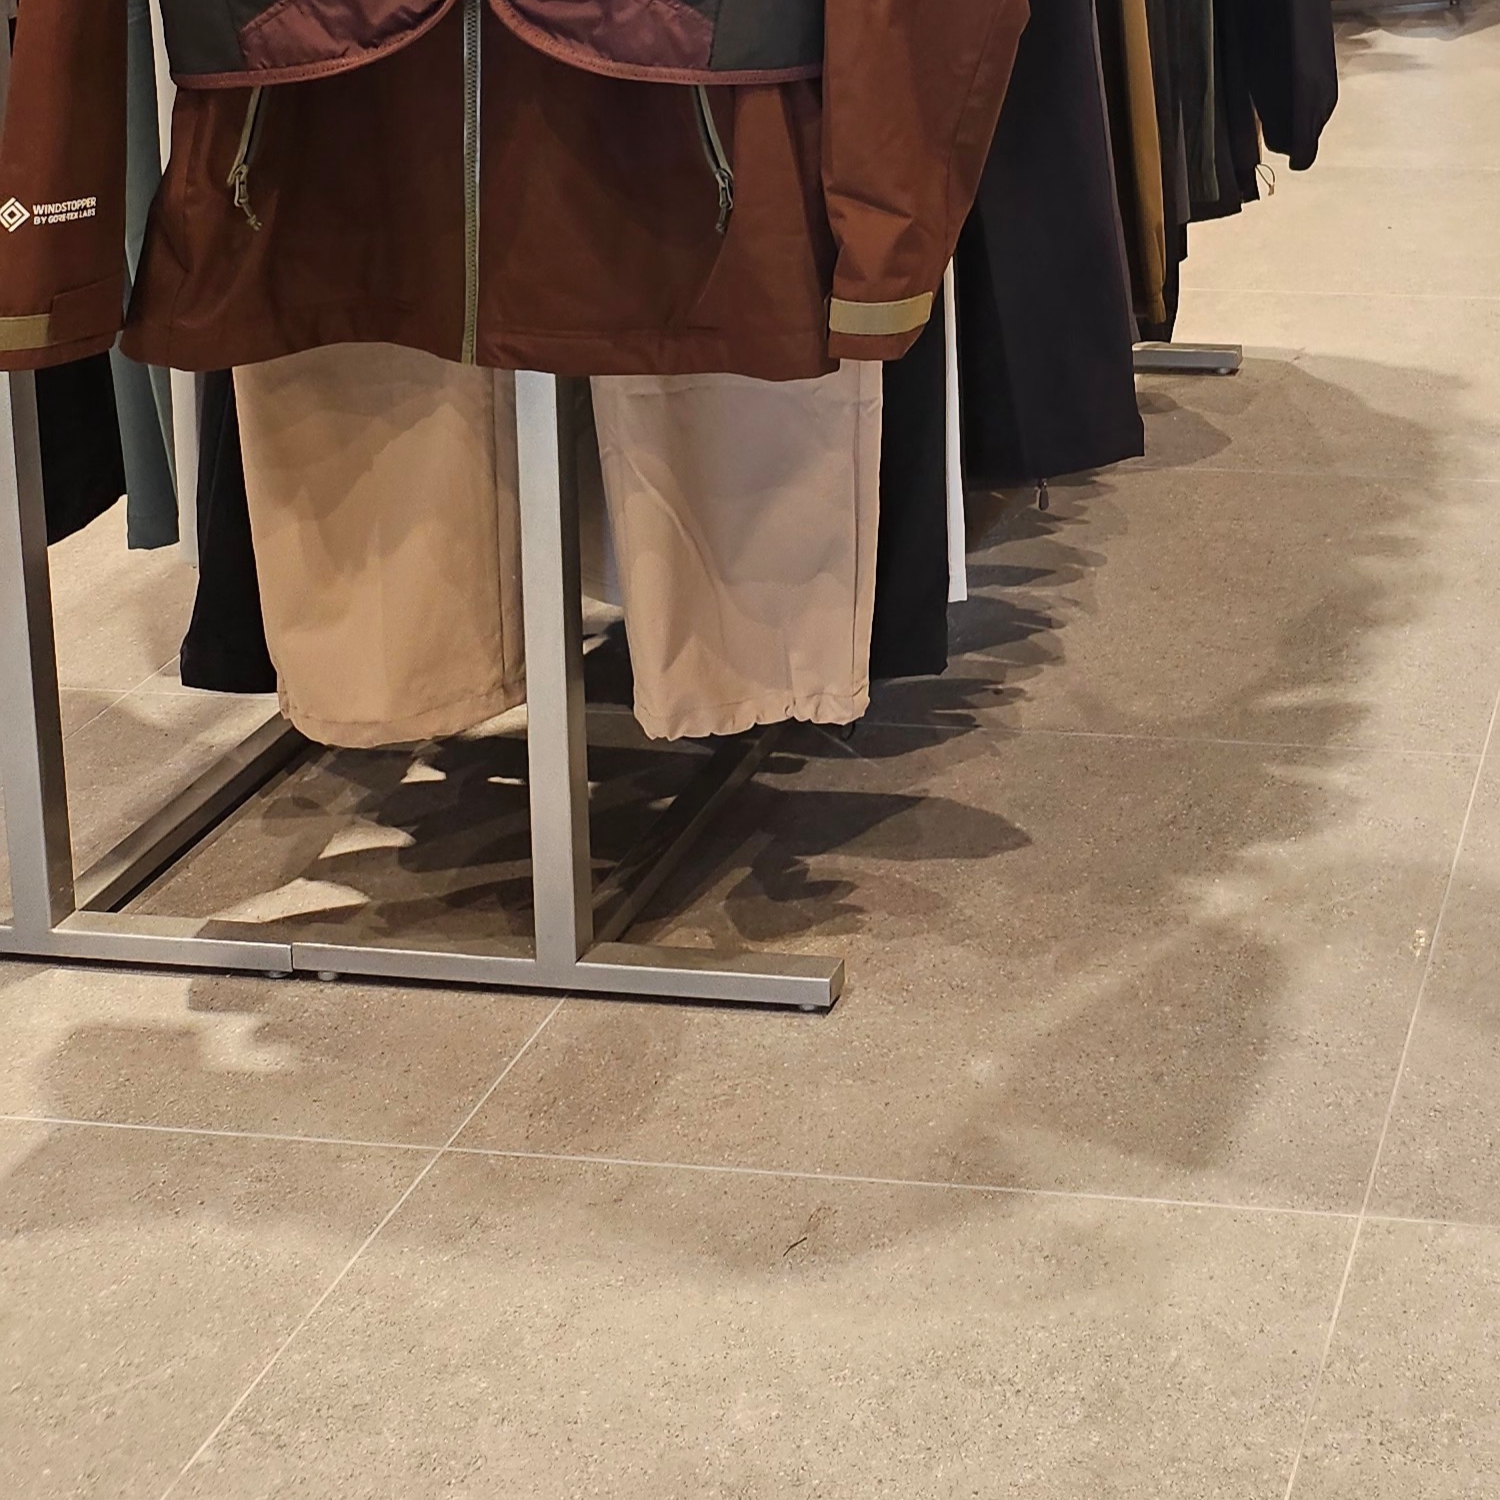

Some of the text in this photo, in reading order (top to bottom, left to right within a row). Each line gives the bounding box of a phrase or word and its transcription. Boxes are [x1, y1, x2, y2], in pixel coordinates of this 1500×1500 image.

[32, 196, 97, 216] WINDSTOPPER
[33, 208, 96, 226] BY GORE-TEX LABS
